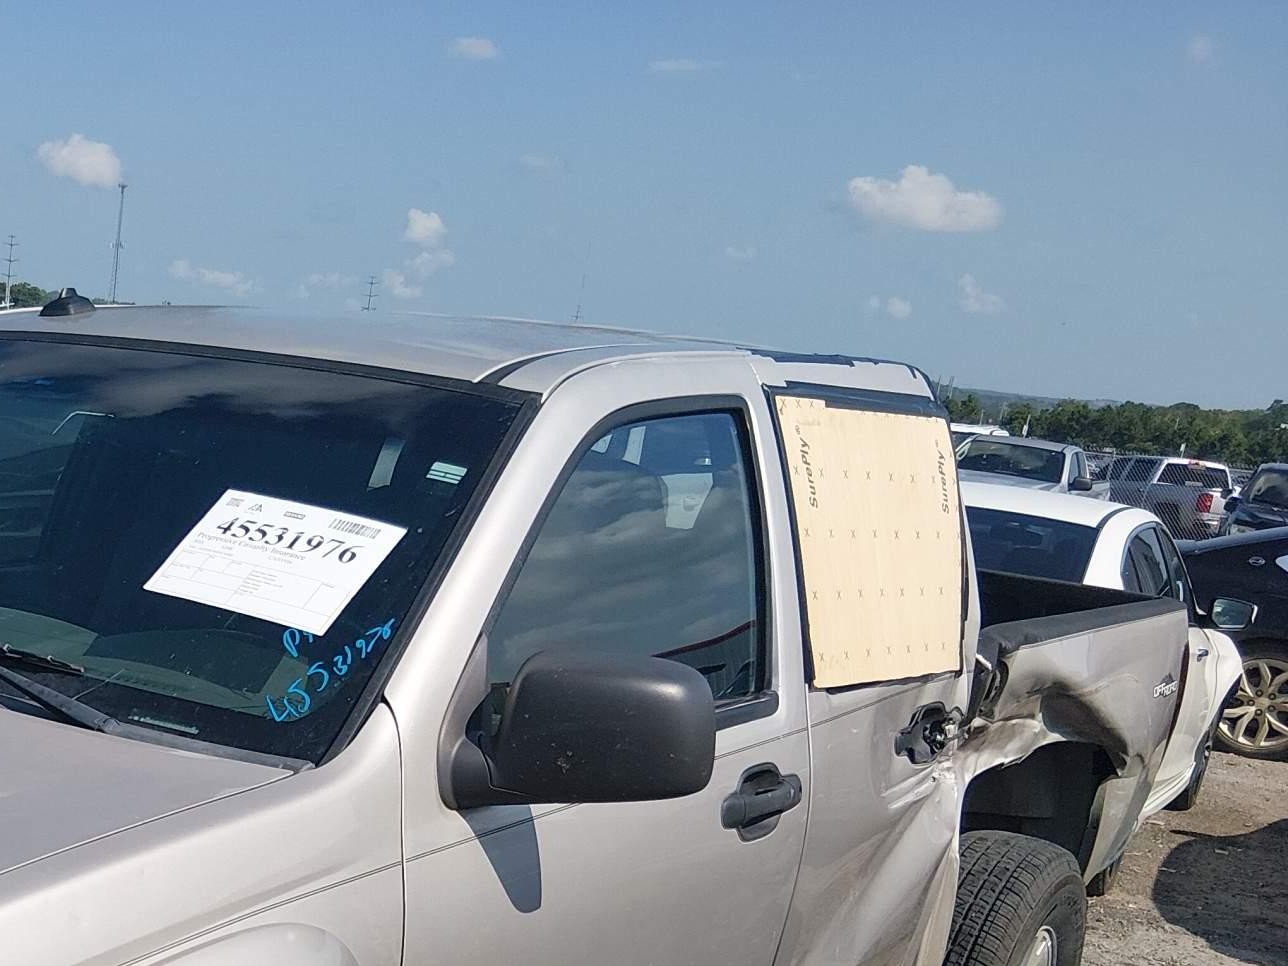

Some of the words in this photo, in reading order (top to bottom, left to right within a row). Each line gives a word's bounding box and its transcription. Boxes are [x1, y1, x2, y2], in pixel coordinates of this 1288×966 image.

[799, 437, 819, 509] SurePly
[935, 449, 950, 514] SurePly
[216, 516, 365, 564] 45531976
